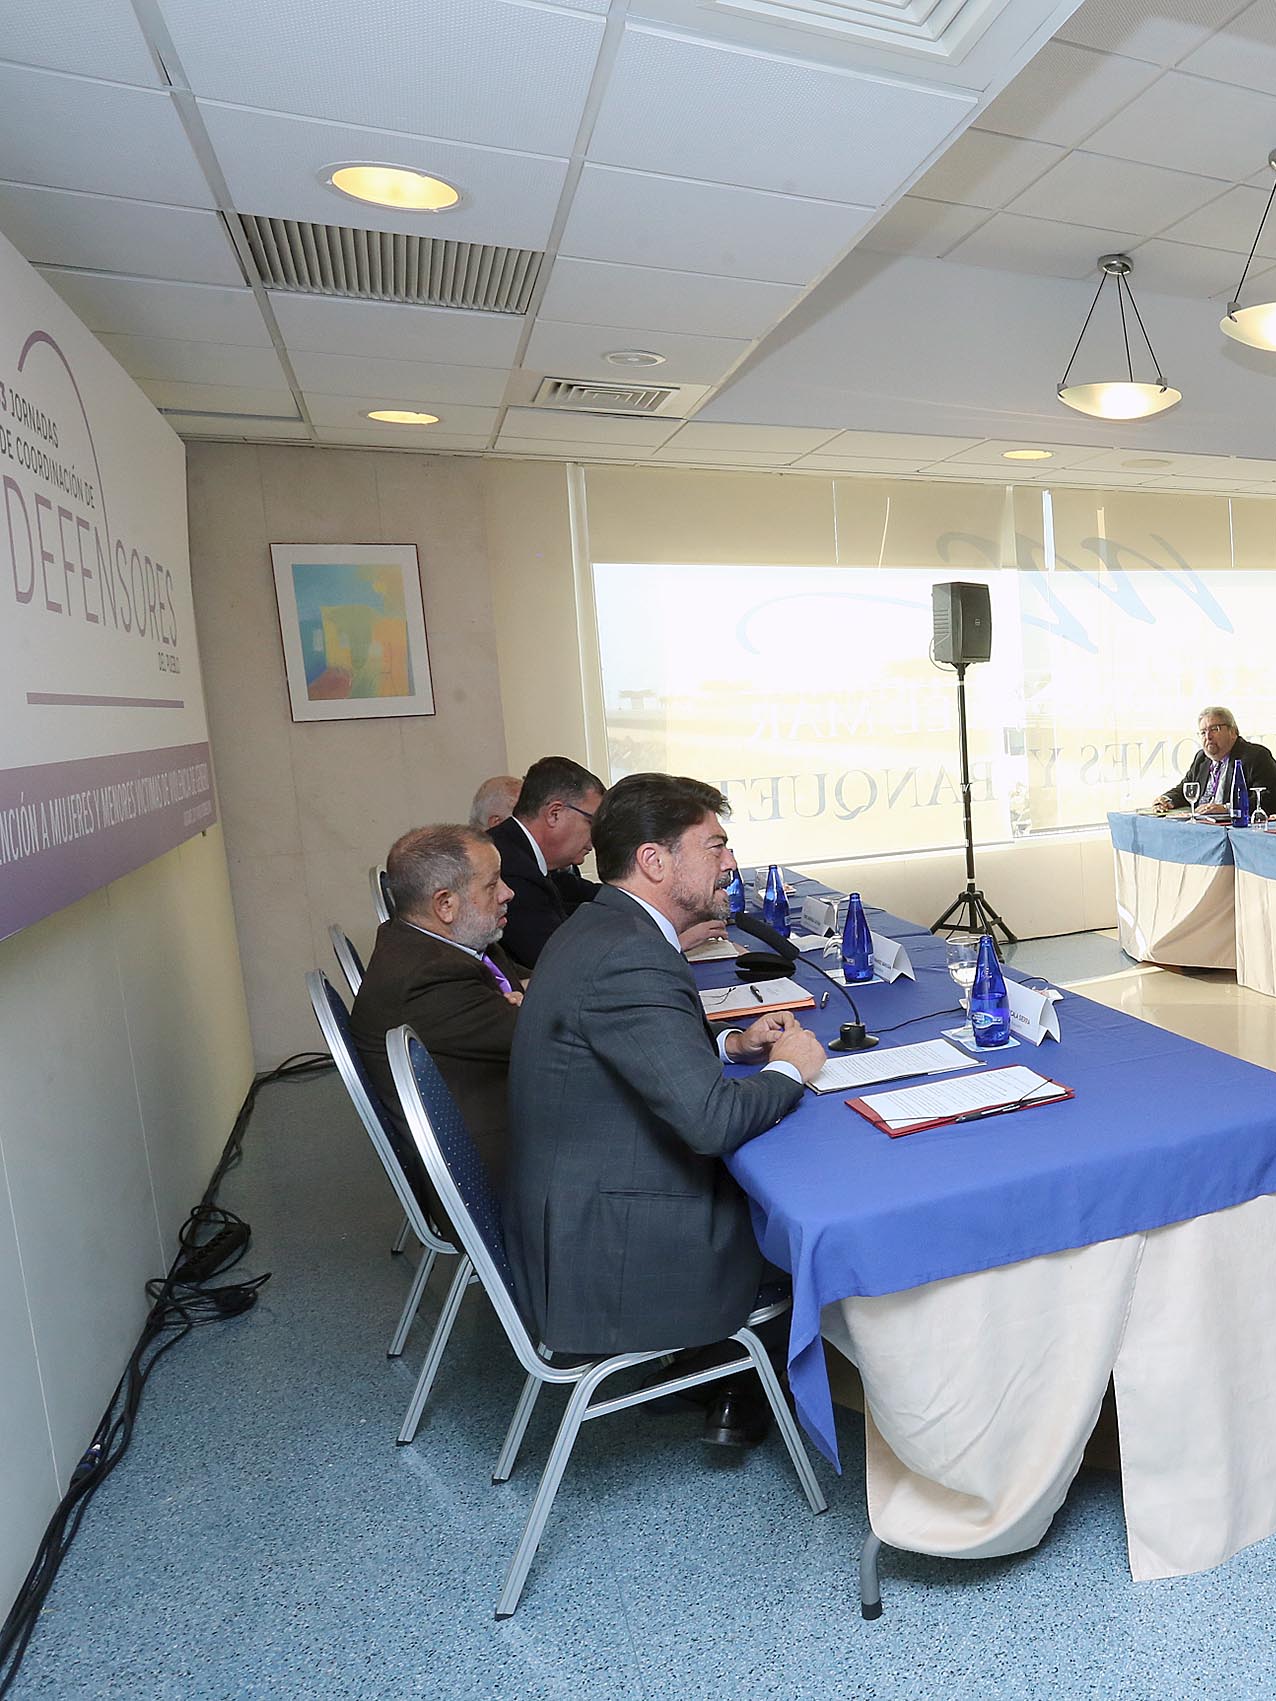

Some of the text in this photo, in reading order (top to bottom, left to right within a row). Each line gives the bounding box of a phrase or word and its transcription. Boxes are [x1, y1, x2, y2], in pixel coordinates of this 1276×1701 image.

[9, 388, 59, 448] JORNADAS
[0, 424, 95, 509] DE COORDINACIÓN DE
[3, 474, 178, 648] DEFENSORES
[0, 791, 40, 866] NCIÓN
[40, 801, 50, 850] A
[49, 790, 95, 847] MUJERES
[93, 788, 101, 831] Y
[100, 780, 137, 828] MENORES
